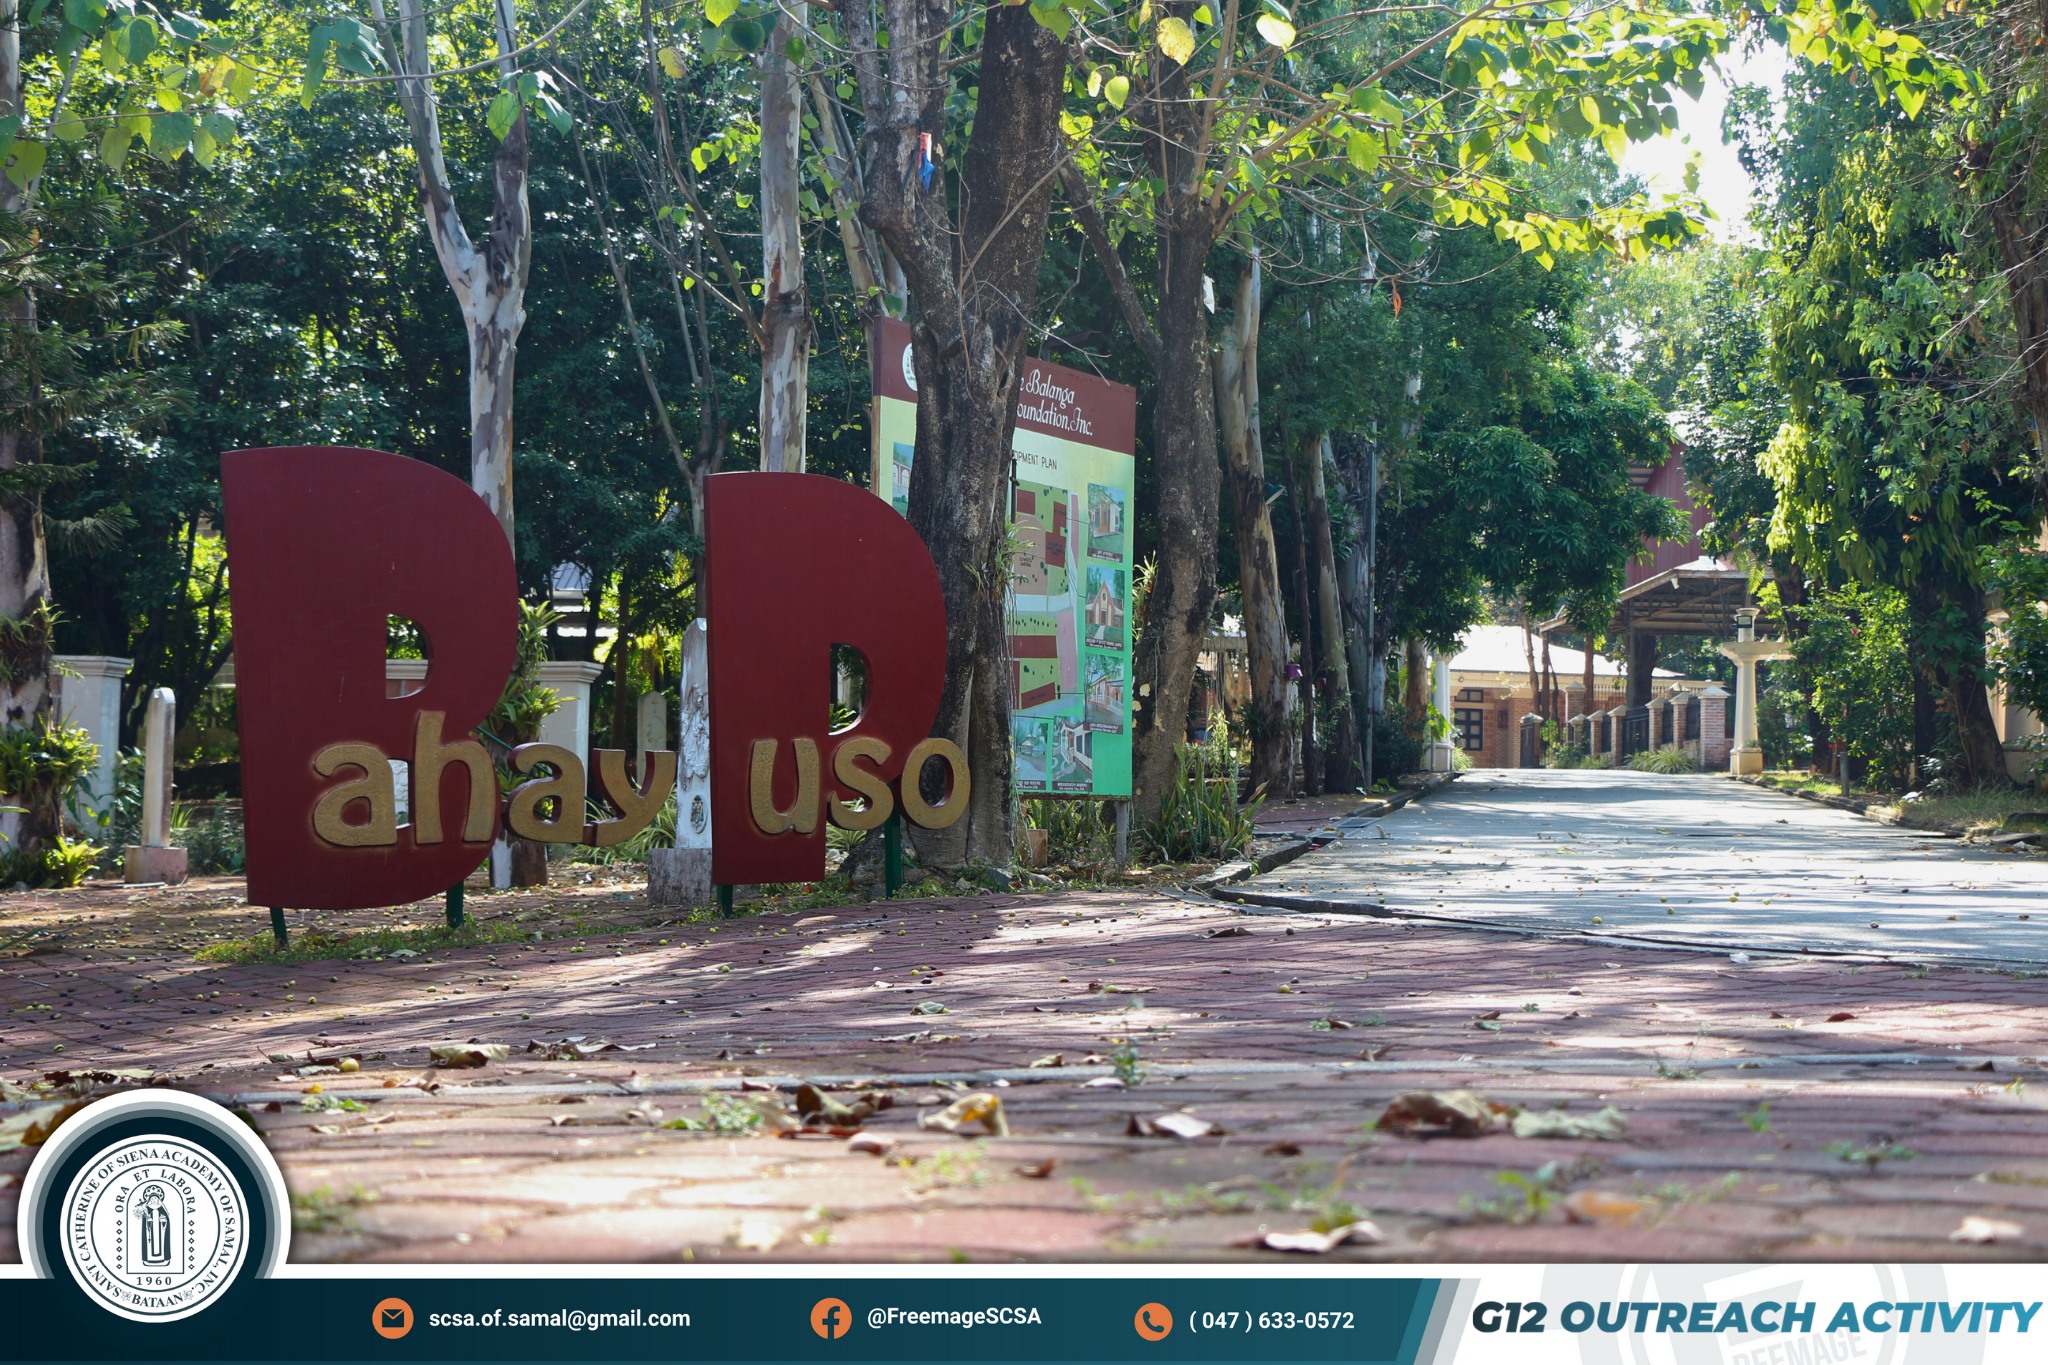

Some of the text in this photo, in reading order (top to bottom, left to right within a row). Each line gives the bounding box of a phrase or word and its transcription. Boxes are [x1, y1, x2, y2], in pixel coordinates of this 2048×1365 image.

[1026, 369, 1075, 409] Balanga
[1016, 399, 1070, 431] oundation,
[1013, 450, 1058, 470] OPMENT PLAN
